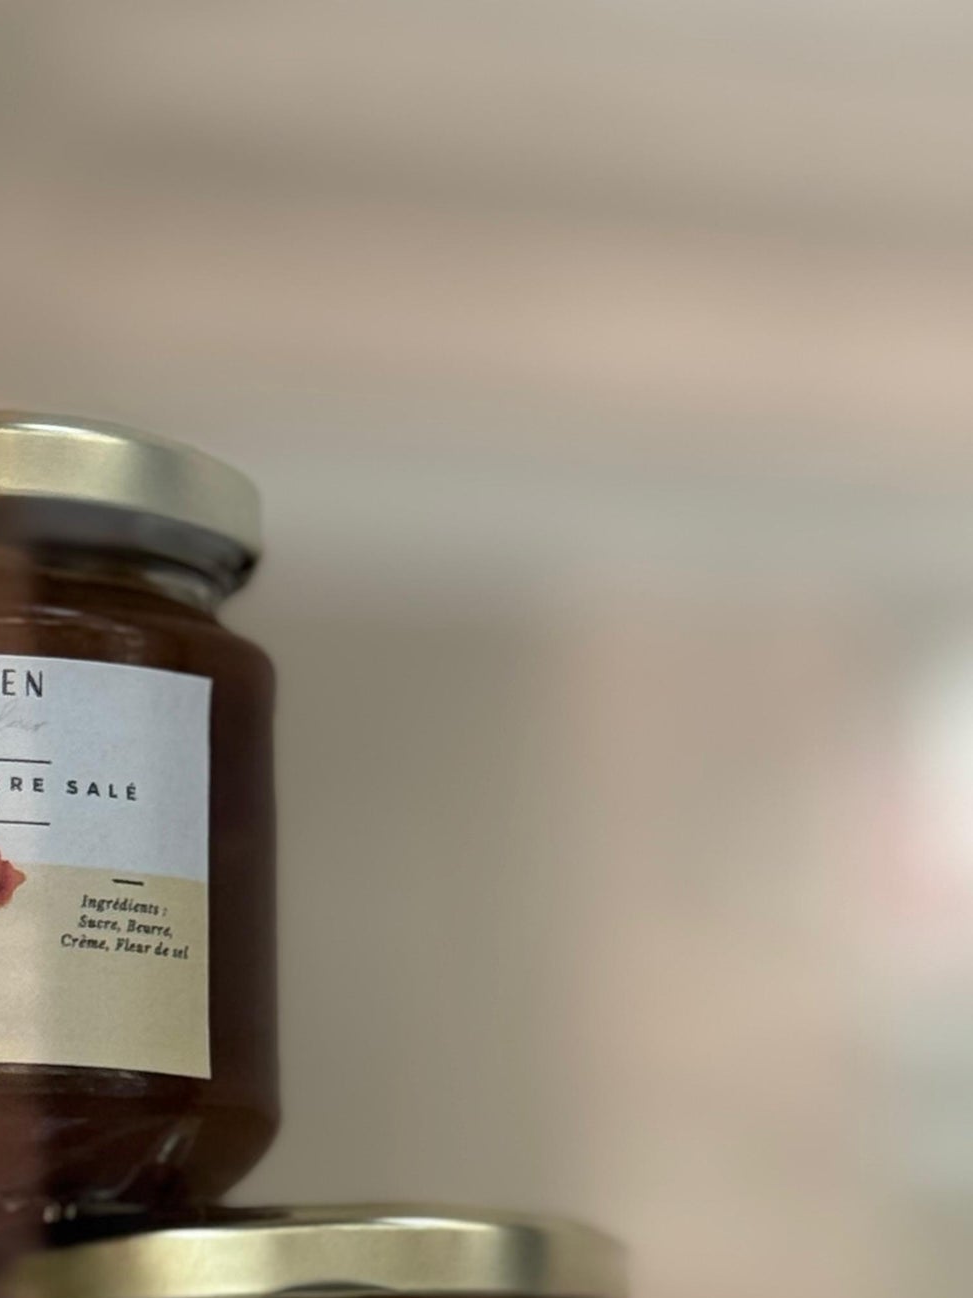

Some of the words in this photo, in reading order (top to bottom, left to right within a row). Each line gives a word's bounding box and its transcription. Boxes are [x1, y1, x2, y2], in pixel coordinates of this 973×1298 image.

[65, 775, 137, 801] SALÉ
[81, 894, 159, 916] Ingrédients
[78, 914, 122, 933] Sucre,
[126, 918, 173, 939] Beurre,
[60, 933, 110, 952] Crème,
[115, 937, 152, 954] Fleur
[154, 941, 169, 957] de
[172, 945, 189, 959] sel
